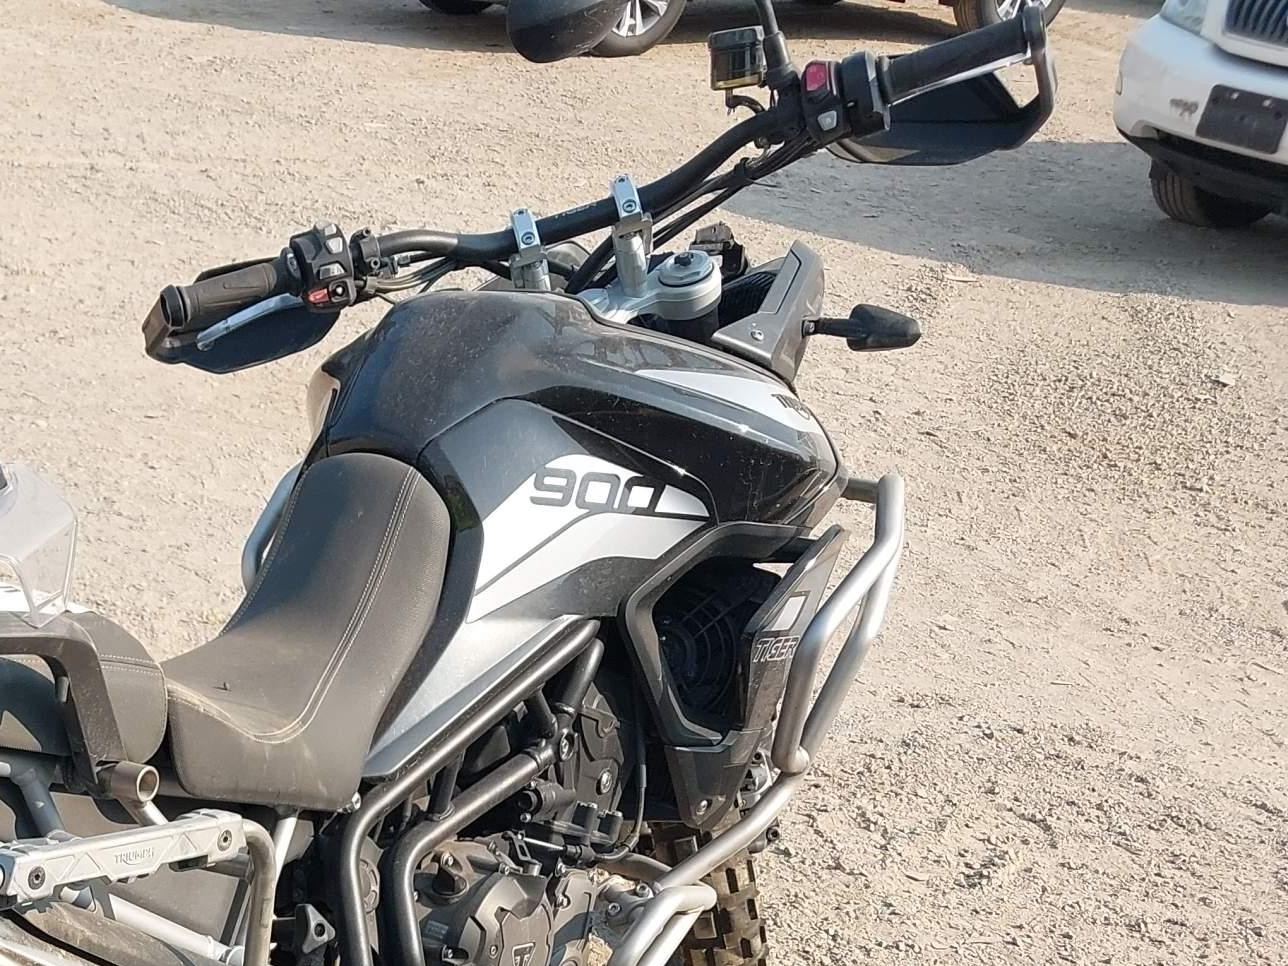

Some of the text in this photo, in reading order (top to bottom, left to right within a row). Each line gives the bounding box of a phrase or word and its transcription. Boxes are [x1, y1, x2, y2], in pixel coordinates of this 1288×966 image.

[529, 466, 668, 514] 900
[752, 635, 801, 663] TIGER
[113, 846, 155, 866] TRIUMPH
